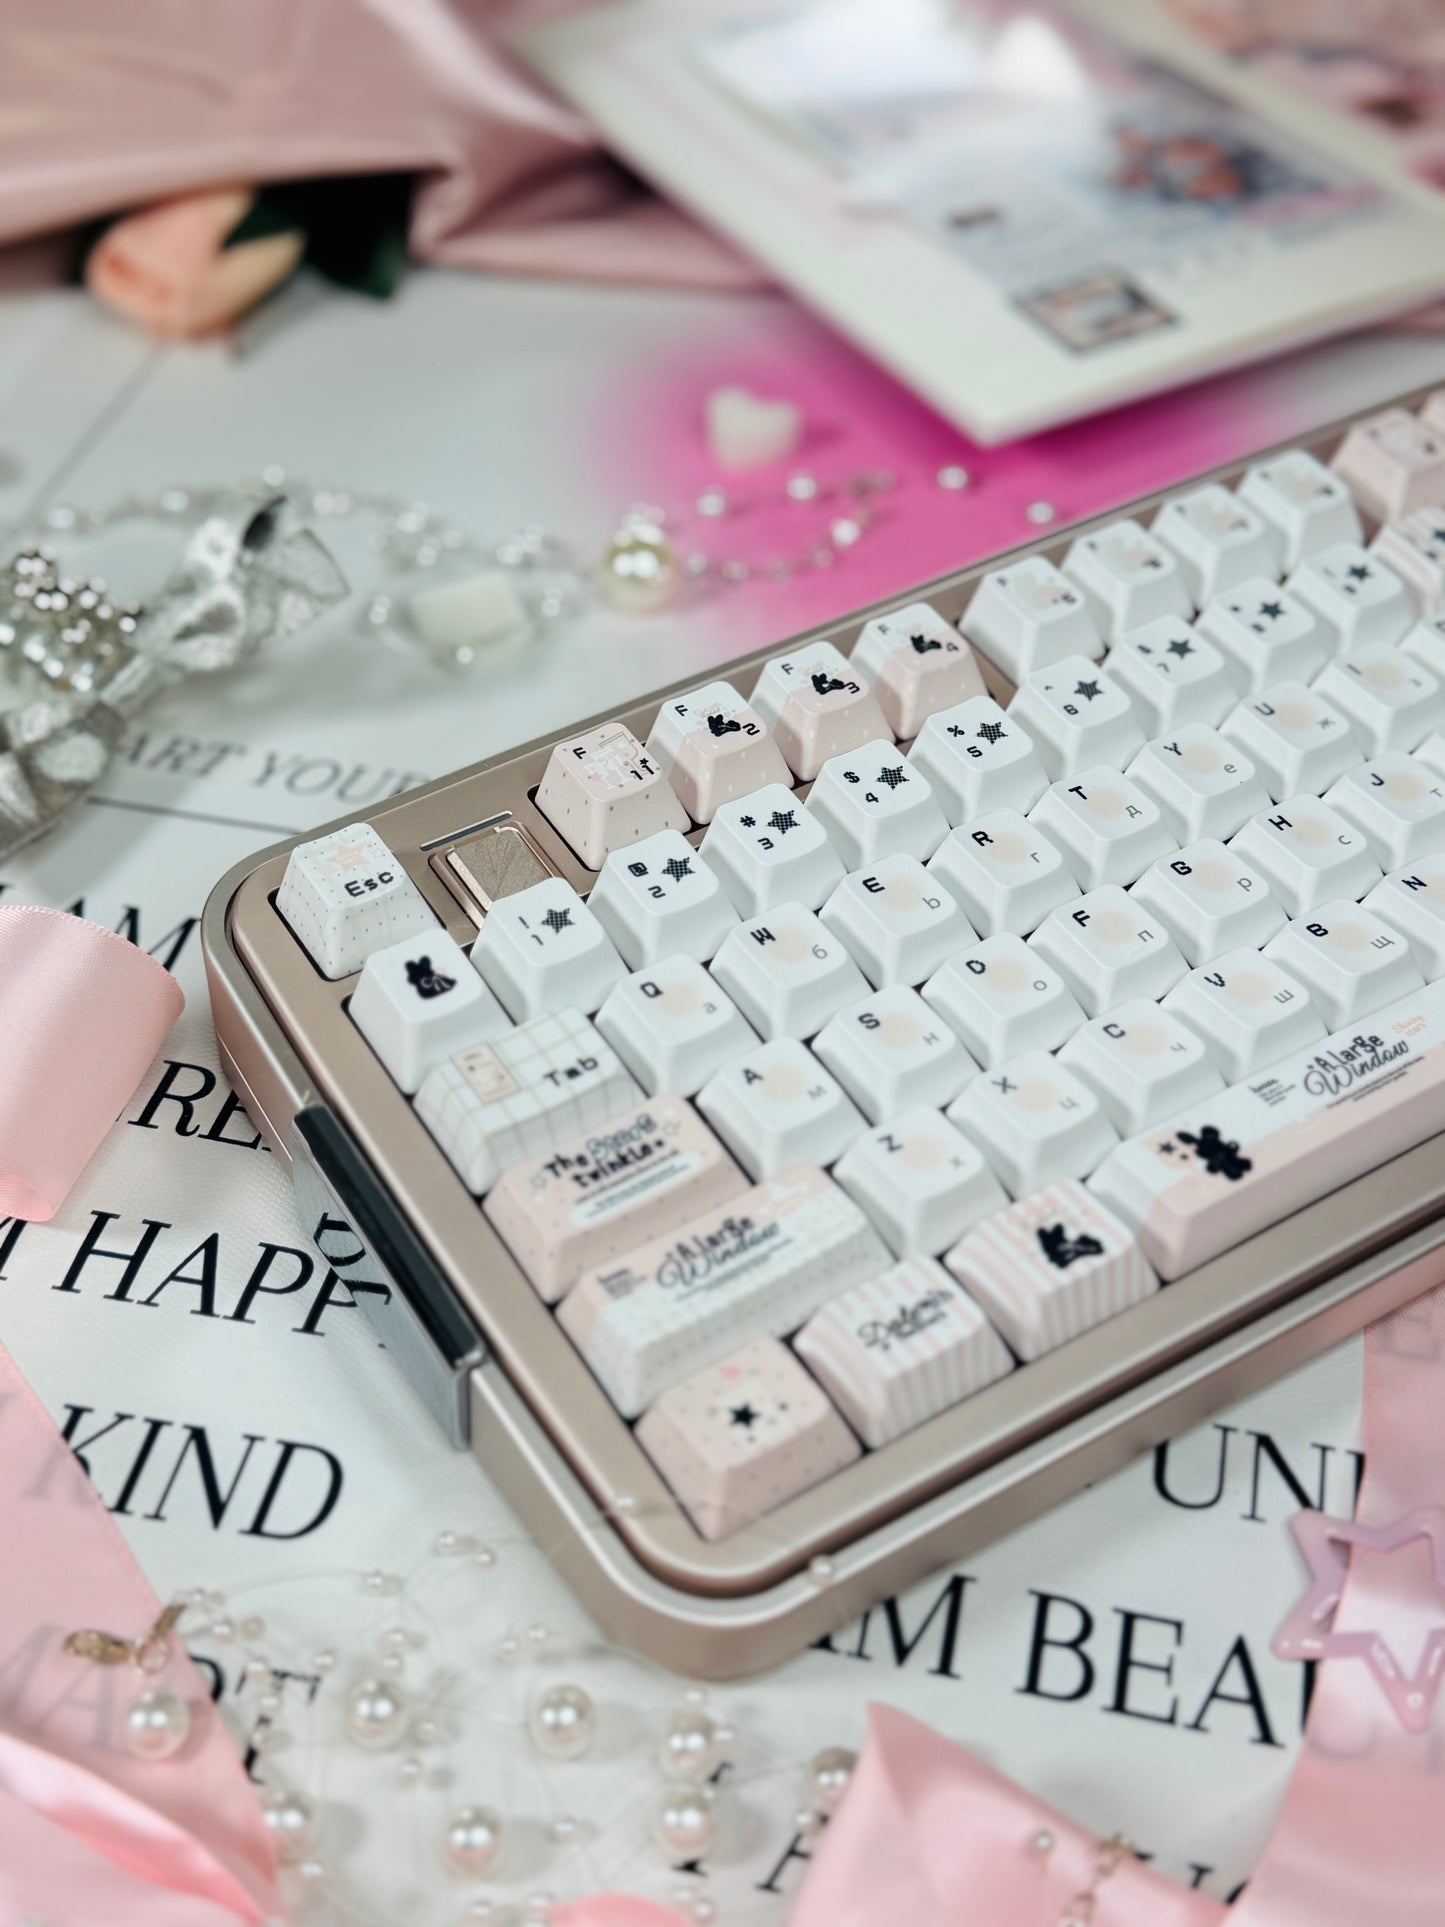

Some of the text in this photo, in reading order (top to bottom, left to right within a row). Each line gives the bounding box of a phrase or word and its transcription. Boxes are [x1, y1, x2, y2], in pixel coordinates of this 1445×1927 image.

[780, 662, 795, 676] F
[845, 680, 861, 696] 3
[1254, 703, 1276, 717] U
[674, 704, 689, 717] F
[741, 721, 761, 737] 2
[946, 724, 965, 738] %
[572, 746, 587, 760] F
[1163, 742, 1183, 756] Y
[842, 771, 861, 784] $
[1371, 773, 1385, 787] J
[865, 792, 879, 803] 4
[1068, 785, 1088, 801] T
[739, 815, 757, 828] #
[1267, 814, 1293, 831] H
[757, 837, 775, 851] 3
[971, 830, 994, 847] R
[627, 861, 649, 878] @
[1170, 860, 1193, 876] G
[344, 871, 394, 898] Esc
[862, 876, 886, 894] E
[1401, 875, 1428, 891] N
[647, 885, 667, 899] 2
[1071, 909, 1091, 928] F
[750, 927, 777, 946] W
[1305, 923, 1329, 938] B
[965, 959, 987, 975] D
[1203, 972, 1226, 988] V
[639, 981, 664, 999] Q
[857, 1012, 881, 1030] S
[1102, 1023, 1126, 1039] C
[1327, 1035, 1385, 1067] large
[543, 1057, 599, 1086] Tab
[1303, 1039, 1410, 1096] Window
[743, 1068, 763, 1085] A
[990, 1075, 1018, 1095] X
[116, 1060, 272, 1152] RE
[878, 1134, 903, 1153] Z
[545, 1154, 588, 1178] The
[51, 1209, 359, 1338] HAPP
[58, 1403, 344, 1540] KIND
[1016, 1588, 1317, 1750] BEA
